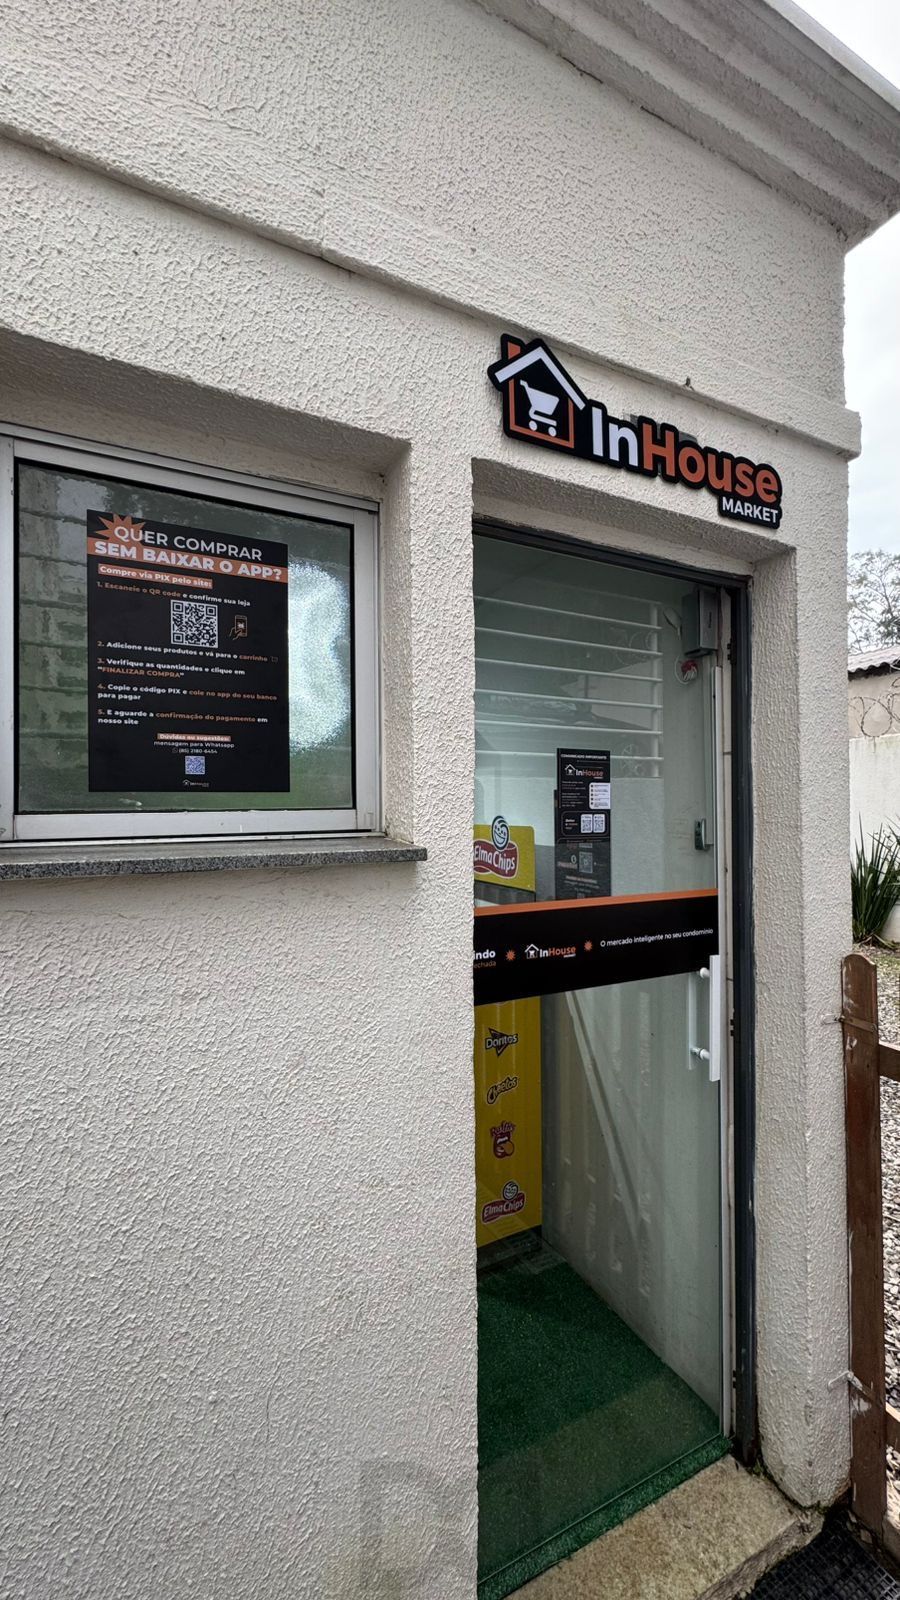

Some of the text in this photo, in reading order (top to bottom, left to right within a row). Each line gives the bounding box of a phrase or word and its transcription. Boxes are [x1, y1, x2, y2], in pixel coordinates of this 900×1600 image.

[592, 407, 778, 503] InHouse
[722, 496, 778, 522] MARKET
[114, 526, 262, 561] QUER COMPRAR
[95, 541, 282, 580] SEM BAIXAR O APP?
[100, 566, 212, 587] Compre via PIX pelo site:
[105, 582, 140, 592] Escaneie
[189, 594, 222, 602] confirme
[106, 642, 142, 650] Adicione
[164, 647, 197, 656] produtos
[106, 658, 144, 667] Verifique
[156, 663, 203, 672] quantidades
[140, 686, 166, 694] código
[155, 712, 203, 720] confirmação
[607, 937, 632, 946] mercado
[634, 935, 663, 943] inteligente
[539, 947, 576, 958] InHouse
[486, 1034, 518, 1048] Doritos
[487, 1076, 518, 1104] Cheetos
